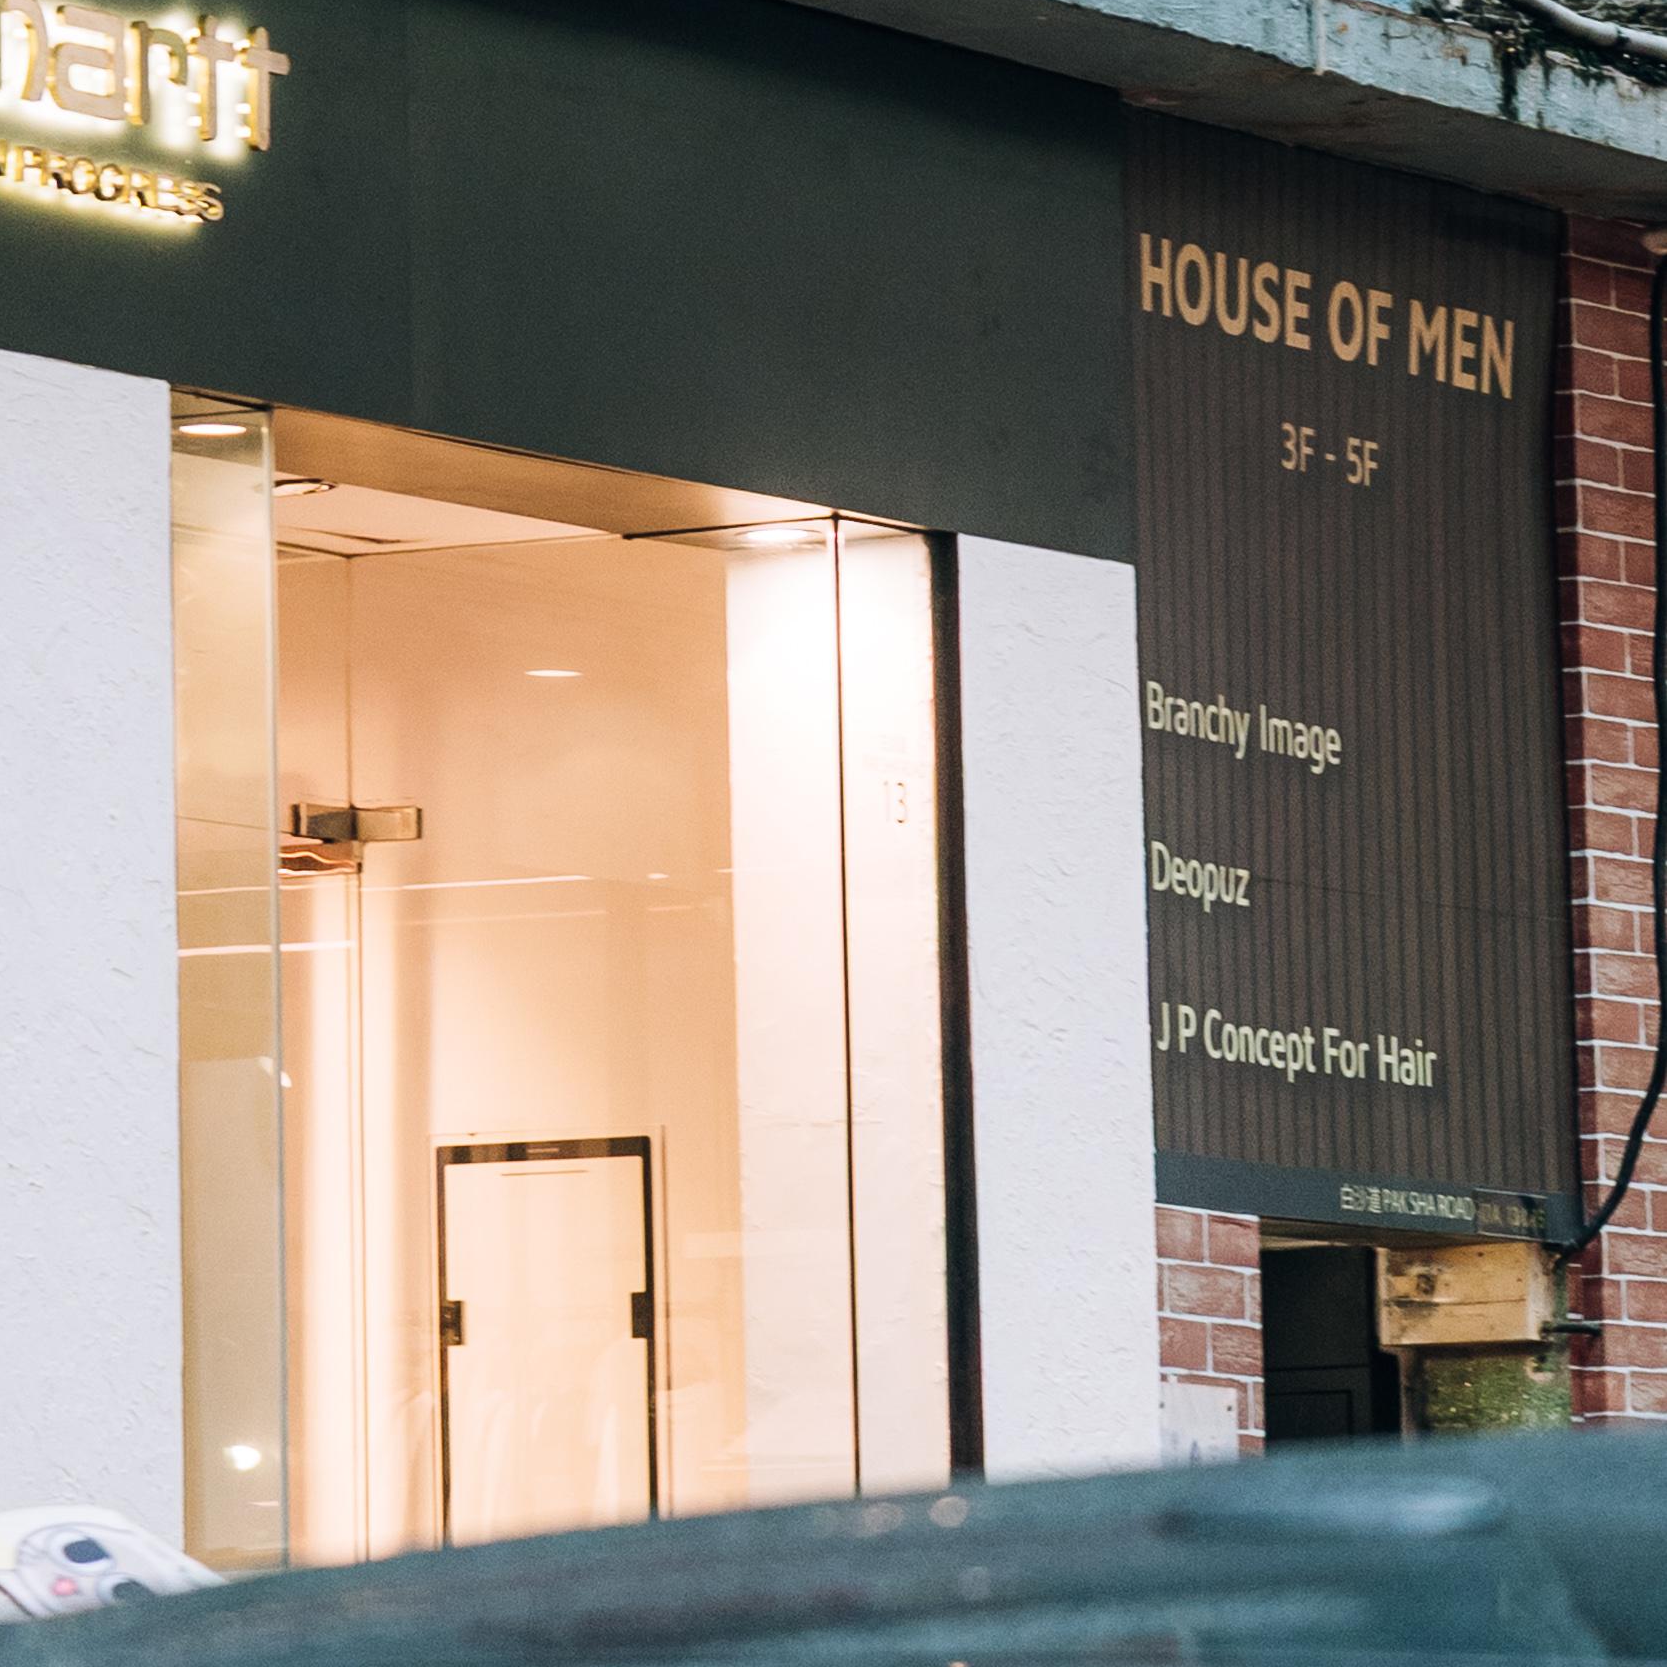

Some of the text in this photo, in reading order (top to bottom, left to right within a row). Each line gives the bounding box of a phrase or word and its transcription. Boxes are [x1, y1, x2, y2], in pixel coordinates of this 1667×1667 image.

[1140, 233, 1515, 400] HOUSE OF MEN
[1280, 422, 1316, 473] 3F
[1346, 437, 1379, 487] 5F
[1146, 680, 1342, 775] Branchy Image
[1151, 840, 1251, 914] Deopuz
[1204, 1008, 1316, 1083] Concept
[1323, 1027, 1370, 1079] For
[1378, 1034, 1437, 1088] Hair
